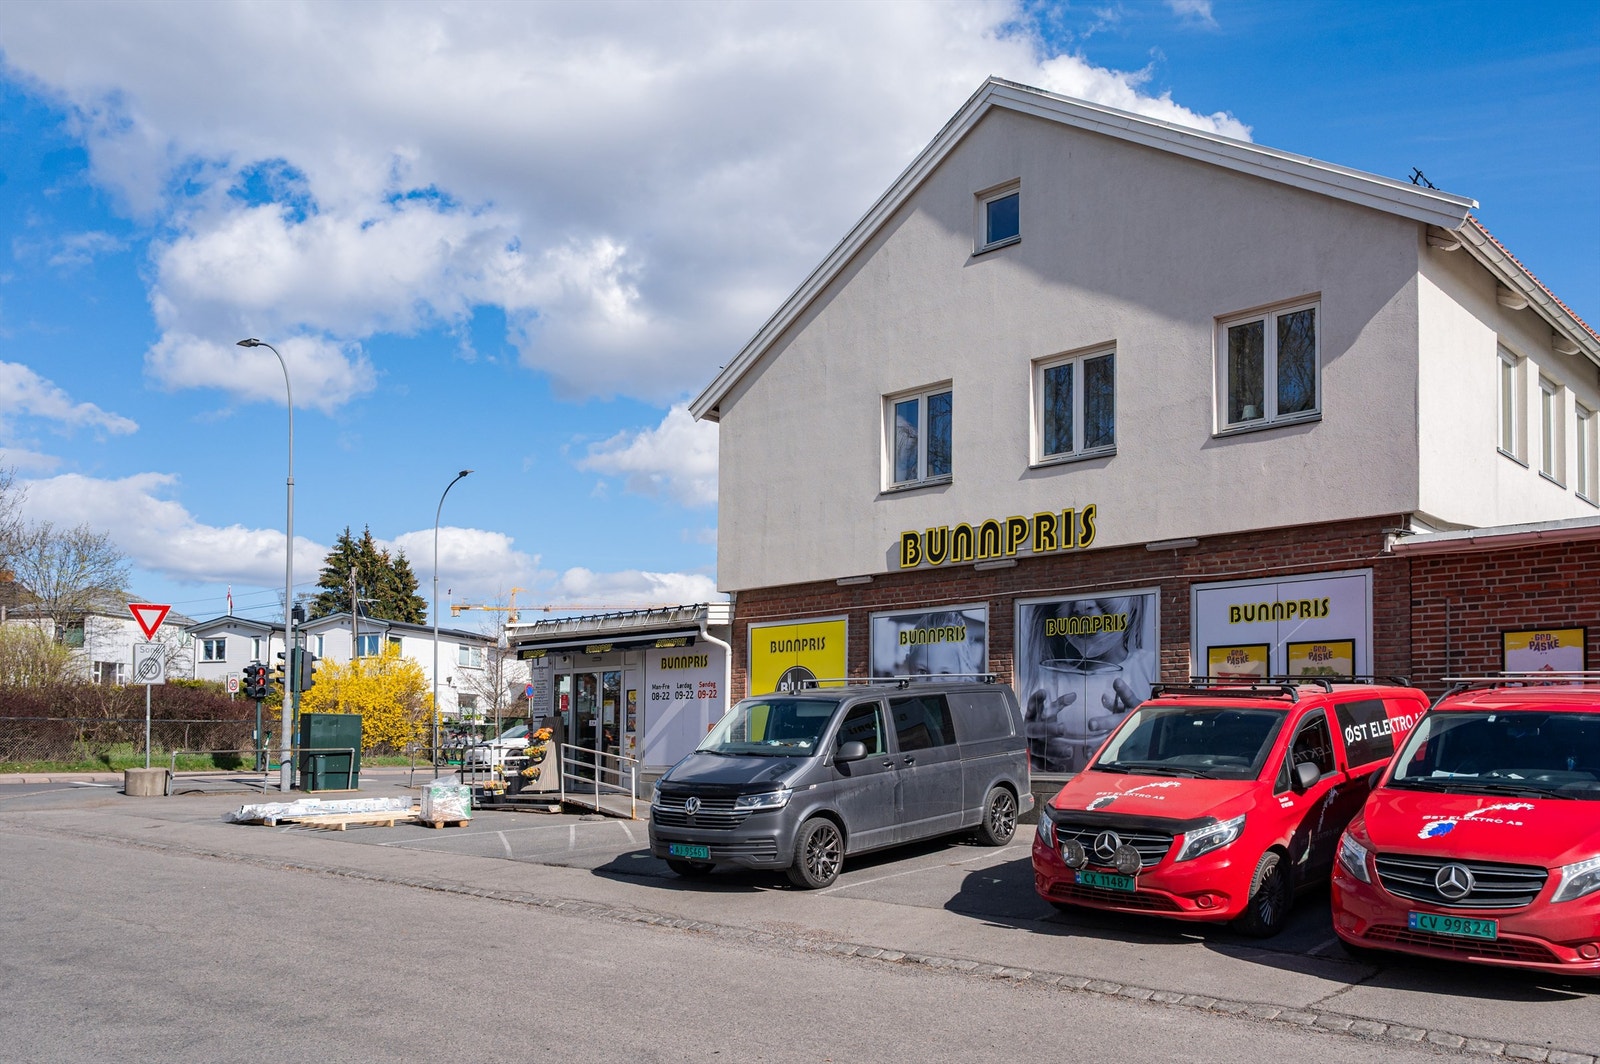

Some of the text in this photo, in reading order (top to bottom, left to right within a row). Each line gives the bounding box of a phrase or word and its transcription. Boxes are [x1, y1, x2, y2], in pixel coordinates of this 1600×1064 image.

[900, 503, 1096, 568] BUNNPRIS
[1229, 597, 1330, 625] BUNNPRIS
[1045, 612, 1128, 637] BUNNPRIS
[899, 626, 967, 646] BUNNPRIS
[770, 637, 826, 654] BUNNPRIS
[661, 654, 709, 670] BUNNPRIS
[676, 682, 692, 690] Lørdag
[698, 681, 717, 689] Søndag
[651, 691, 670, 701] 08-22
[674, 690, 694, 700] 09-22
[697, 689, 718, 700] 09-22
[1345, 714, 1414, 746] ØST ELEKTRO
[1084, 873, 1130, 889] CX 11487
[1420, 915, 1438, 929] CV
[1443, 918, 1492, 936] 99824
